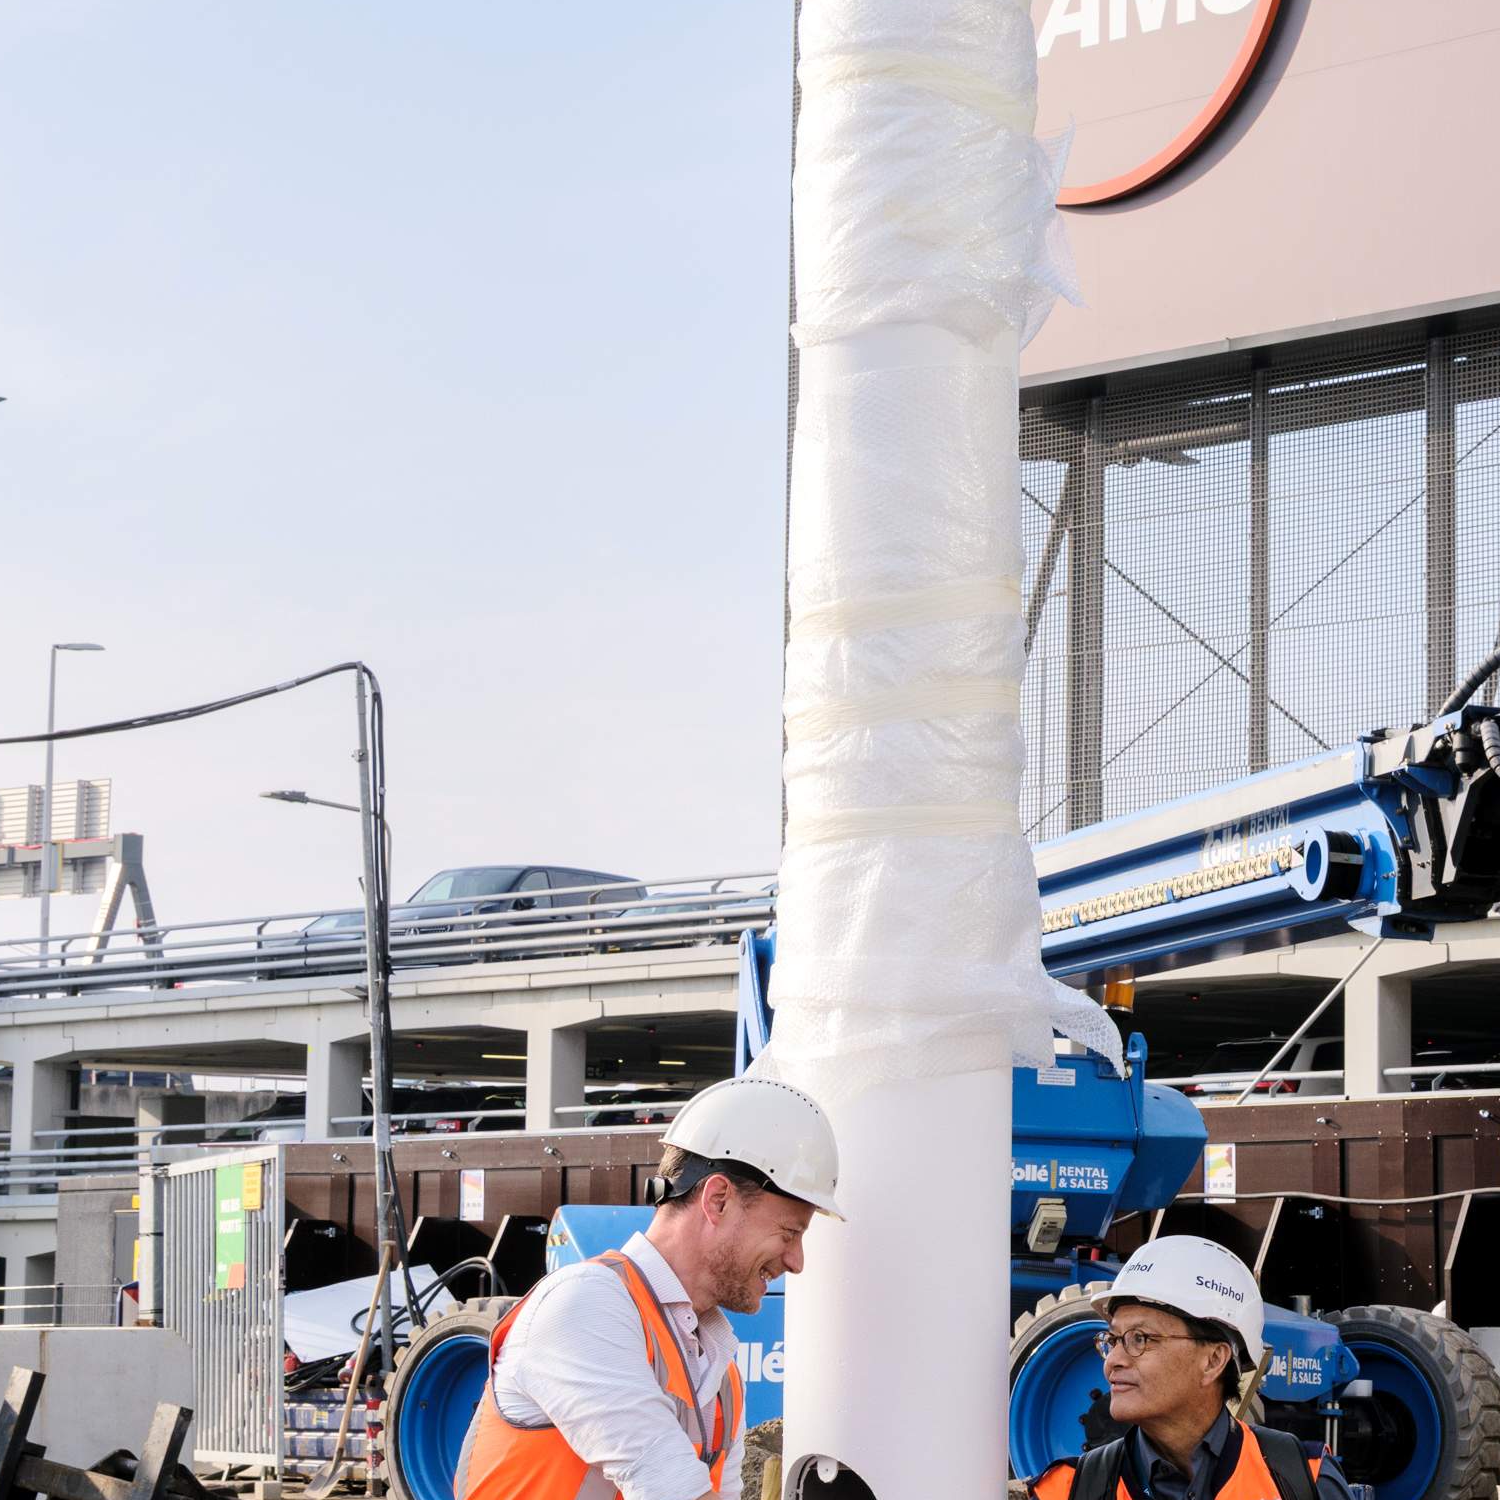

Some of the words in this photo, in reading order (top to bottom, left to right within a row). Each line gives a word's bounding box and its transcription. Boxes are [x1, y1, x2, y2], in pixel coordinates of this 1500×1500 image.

[1012, 1163, 1049, 1181] ollé
[1060, 1166, 1108, 1178] RENTAL
[1059, 1179, 1067, 1188] &
[1070, 1179, 1108, 1189] SALES
[1195, 1275, 1244, 1303] Schiphol
[737, 1341, 784, 1382] llé
[1293, 1357, 1322, 1371] RENTAL
[1299, 1372, 1322, 1385] SALES
